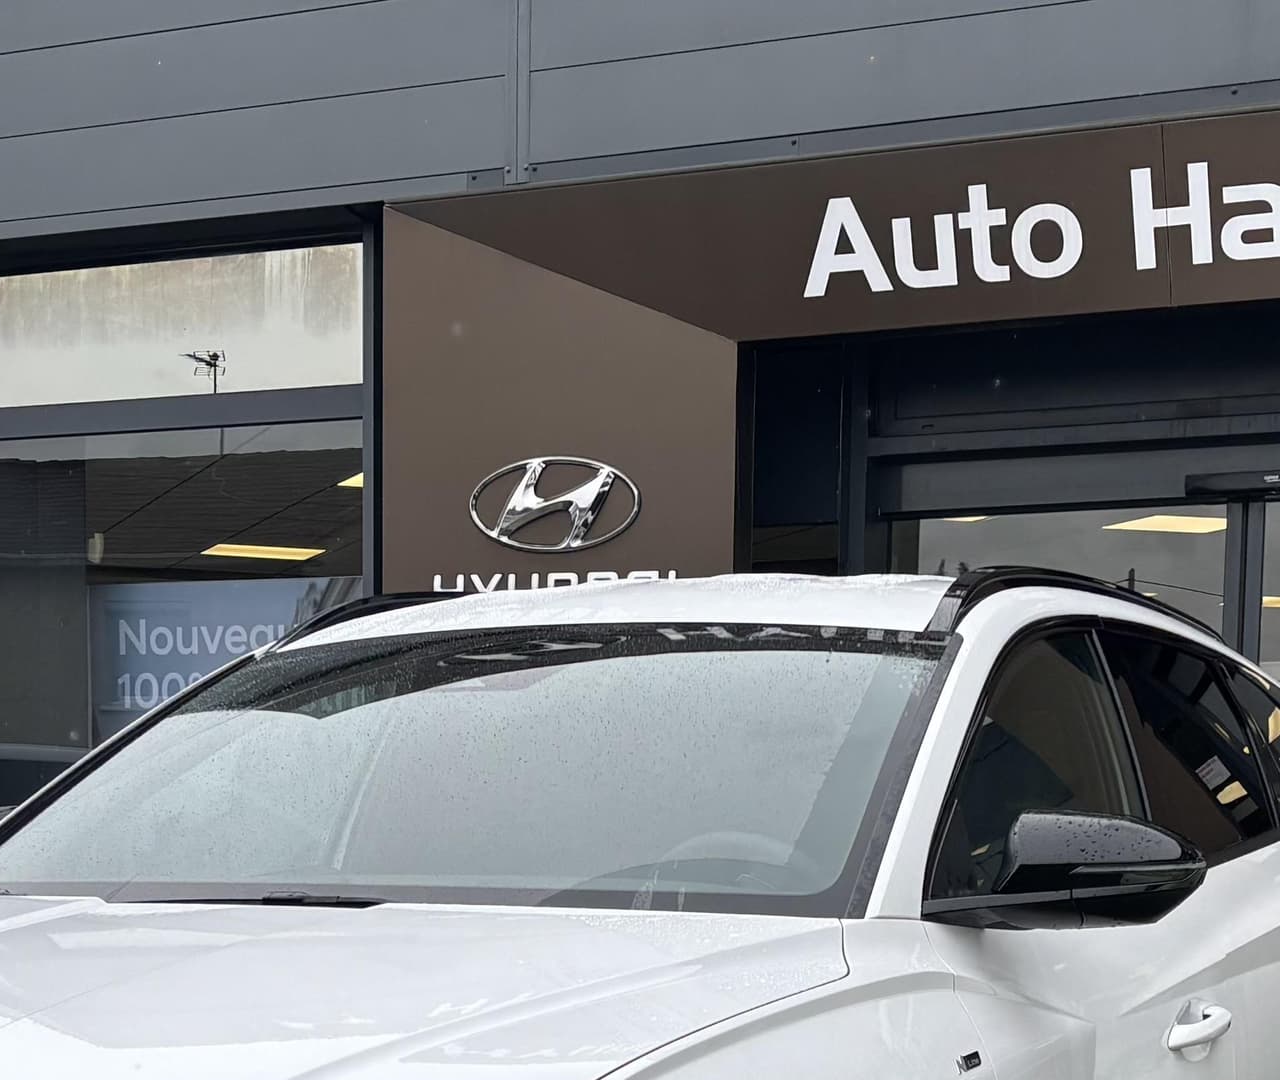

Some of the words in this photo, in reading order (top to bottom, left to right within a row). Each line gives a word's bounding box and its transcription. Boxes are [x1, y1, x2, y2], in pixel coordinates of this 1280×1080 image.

[803, 183, 1083, 297] Auto
[119, 618, 298, 656] Nouvea
[117, 672, 205, 709] 100
